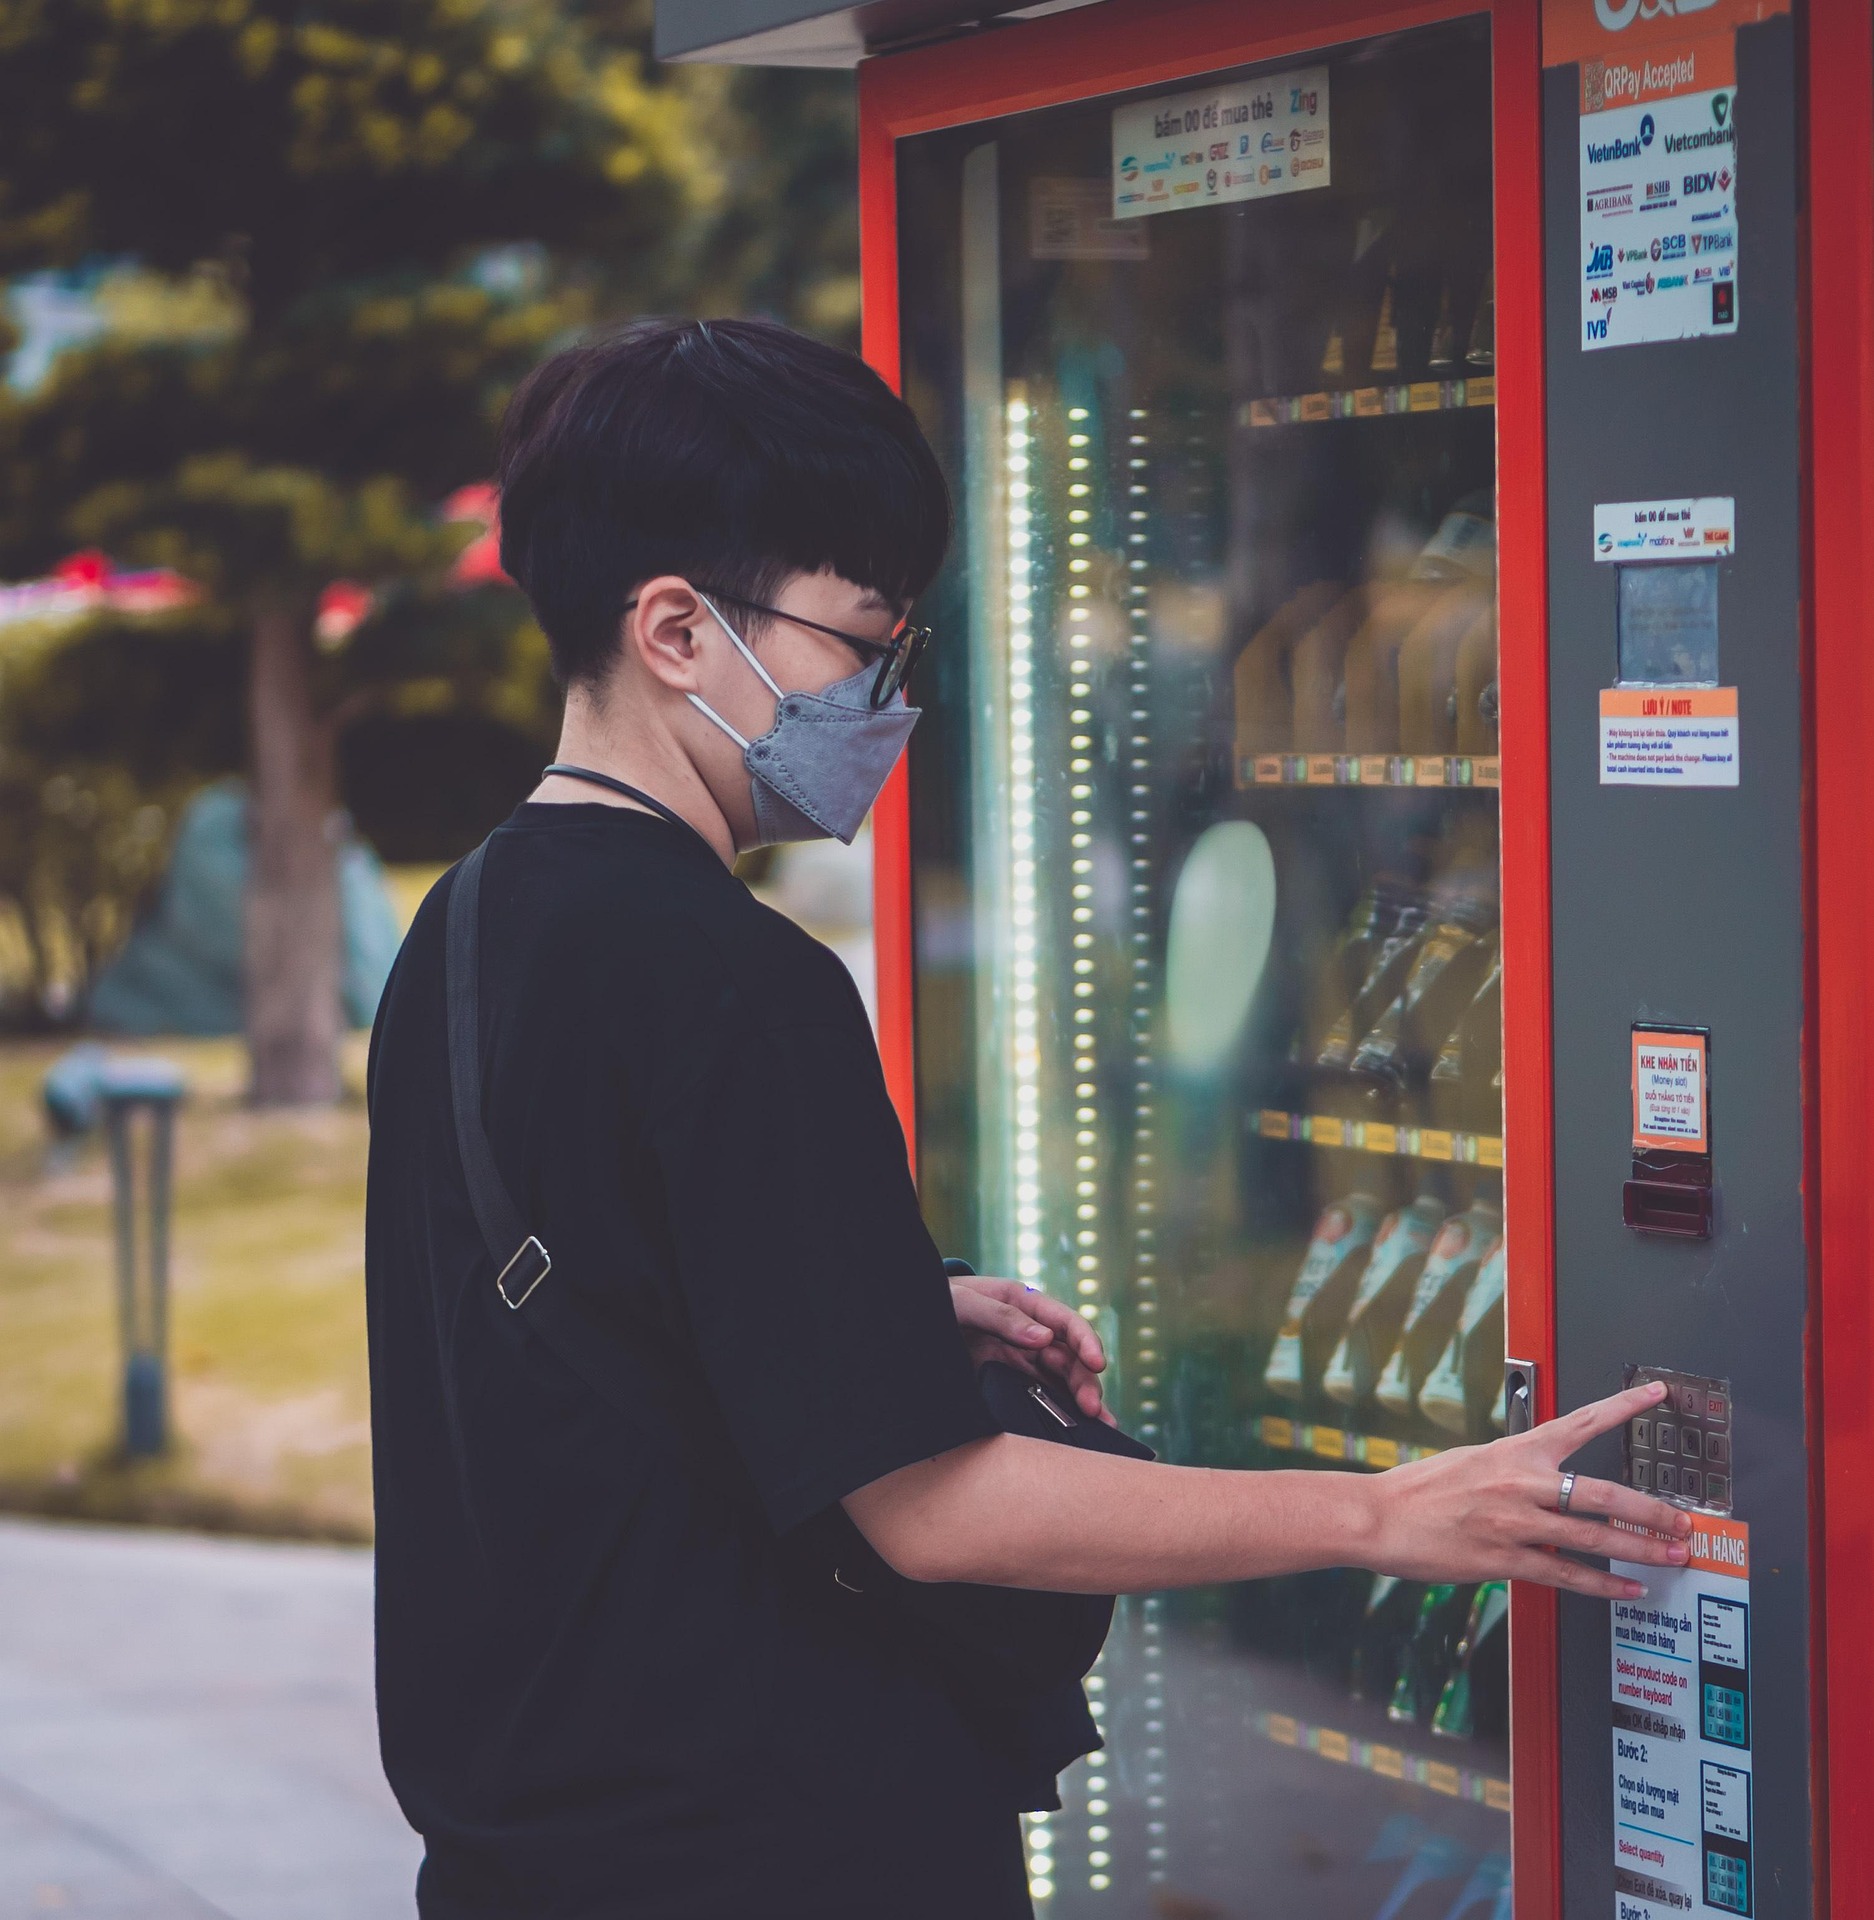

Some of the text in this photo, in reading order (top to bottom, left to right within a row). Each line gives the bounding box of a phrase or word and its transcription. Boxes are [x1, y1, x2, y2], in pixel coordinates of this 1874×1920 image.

[1604, 52, 1695, 100] QRPay Accepted
[1290, 88, 1317, 116] Zing
[1185, 109, 1199, 132] 00
[1221, 104, 1248, 126] mua
[1587, 136, 1642, 164] VietinBank
[1653, 180, 1670, 195] SHB
[1683, 171, 1717, 196] BIDV
[1594, 194, 1634, 211] AGRIBANK
[1662, 234, 1686, 251] SCB
[1702, 232, 1734, 251] TPBank
[1602, 286, 1618, 300] MSB
[1587, 319, 1608, 341] IVB
[1671, 699, 1691, 715] NOTE
[1640, 1055, 1655, 1069] KHE
[1658, 1053, 1678, 1073] NHẬN
[1687, 1394, 1693, 1409] 3
[1638, 1425, 1644, 1440] 4
[1638, 1465, 1644, 1480] 7
[1663, 1470, 1669, 1485] 8
[1688, 1475, 1694, 1490] 9
[1713, 1530, 1745, 1566] HÀNG
[1615, 1602, 1628, 1621] Lựa
[1630, 1604, 1646, 1623] chọn
[1647, 1610, 1660, 1628] mặt
[1661, 1614, 1678, 1633] hàng
[1679, 1613, 1692, 1633] cần
[1615, 1626, 1675, 1654] mua theo mã hàng
[1616, 1658, 1687, 1689] Select product code on
[1618, 1682, 1672, 1706] number keyboard
[1632, 1712, 1642, 1729] OK
[1669, 1723, 1686, 1742] nhận
[1617, 1738, 1648, 1763] Bước 2:
[1618, 1774, 1679, 1805] Chọn số lượng mặt
[1621, 1794, 1664, 1819] hàng cần mua
[1618, 1839, 1665, 1867] Select quantity
[1668, 1892, 1683, 1910] quay
